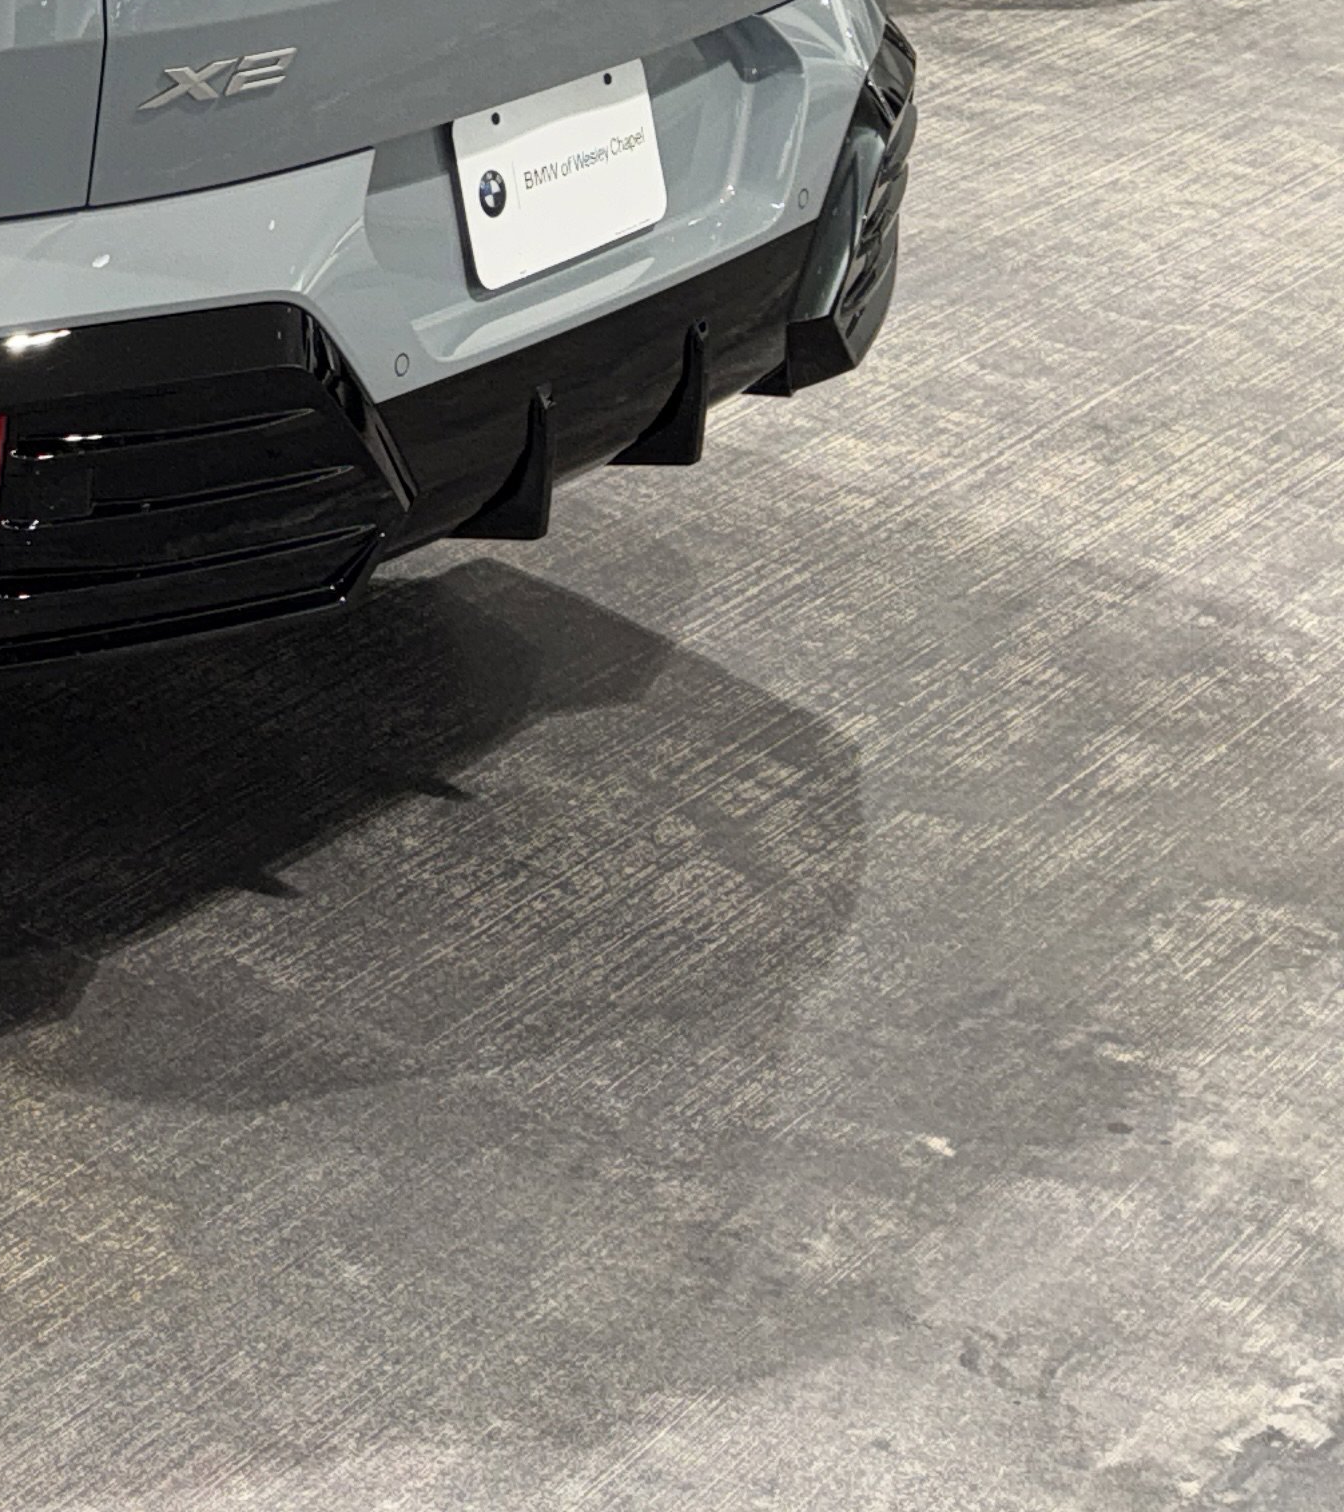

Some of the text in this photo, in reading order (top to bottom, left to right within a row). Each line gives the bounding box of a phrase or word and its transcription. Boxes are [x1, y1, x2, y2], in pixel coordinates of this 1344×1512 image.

[136, 46, 298, 111] X2
[523, 126, 646, 190] BMW of Wesley Chapel
